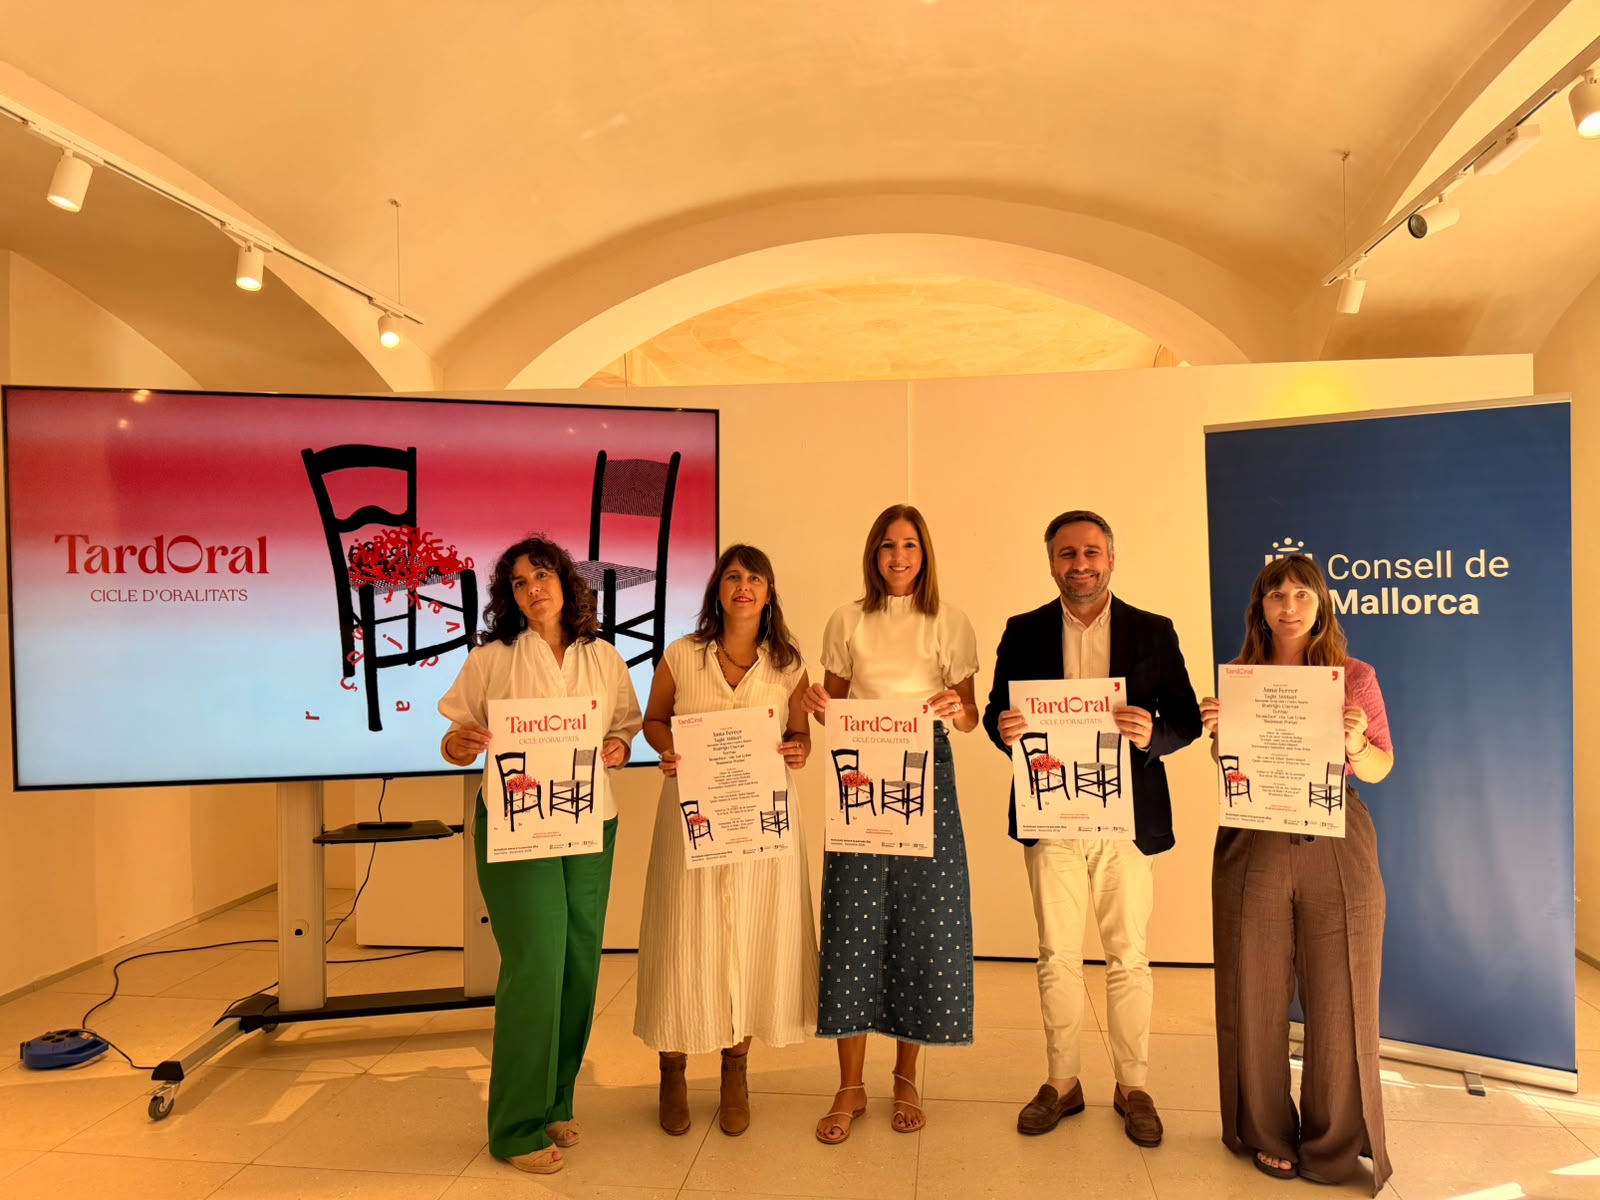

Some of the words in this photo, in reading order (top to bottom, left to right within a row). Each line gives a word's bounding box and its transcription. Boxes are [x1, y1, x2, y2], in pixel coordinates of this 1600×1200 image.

[54, 534, 269, 574] TardOral
[1327, 549, 1452, 581] Consell
[1465, 548, 1510, 578] de
[90, 589, 138, 602] CICLE
[142, 588, 248, 602] D'ORALITATS
[1328, 587, 1480, 615] Mallorca
[1025, 695, 1110, 714] TardOral
[505, 713, 587, 734] TardOral
[840, 715, 918, 733] TardOral
[519, 737, 538, 745] CICLE
[852, 736, 871, 744] CICLE
